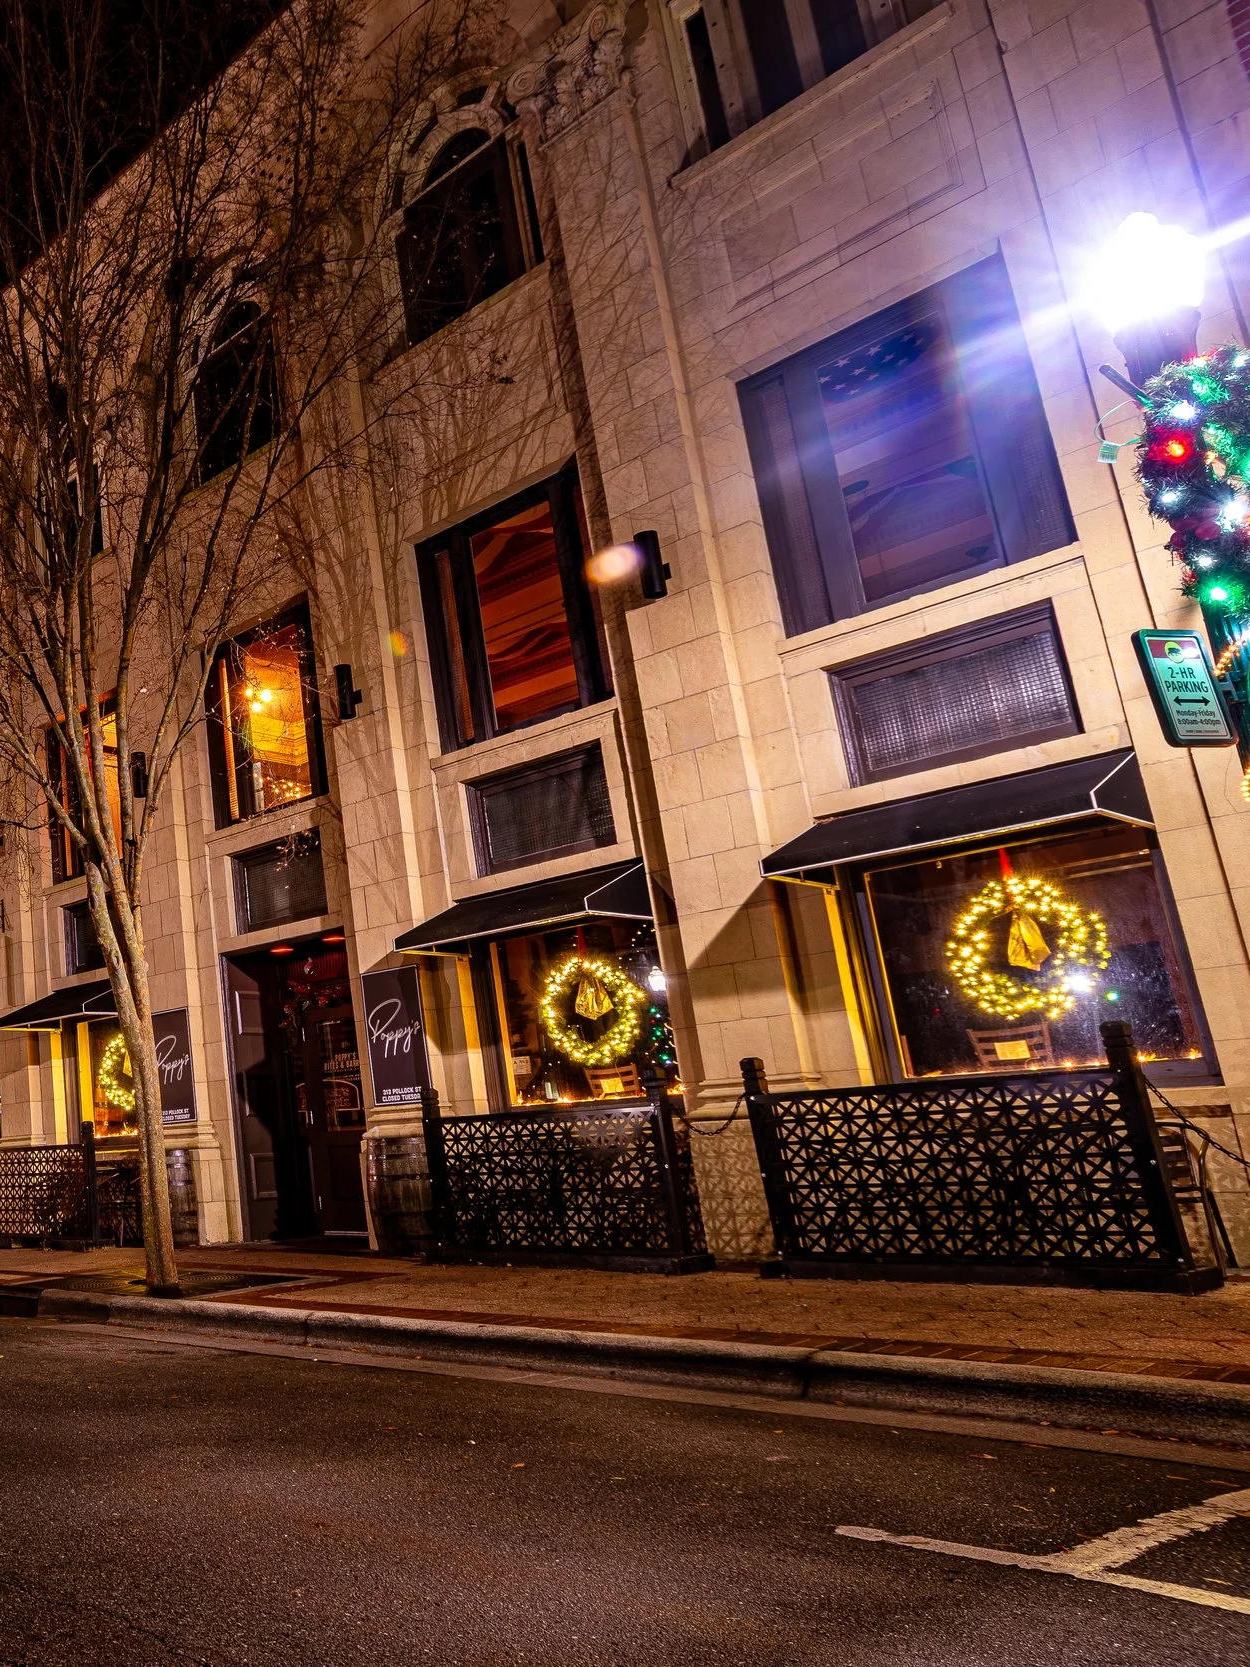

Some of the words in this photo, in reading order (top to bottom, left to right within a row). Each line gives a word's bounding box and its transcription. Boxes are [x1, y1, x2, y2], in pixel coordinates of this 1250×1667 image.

[1168, 667, 1196, 679] 2-HR
[1164, 681, 1209, 693] PARKING
[1175, 709, 1216, 718] Monday-Friday
[368, 999, 421, 1058] Poppy's
[155, 1035, 190, 1085] Poppy's
[392, 1087, 415, 1095] POLLOCK
[382, 1094, 401, 1102] CLOSED
